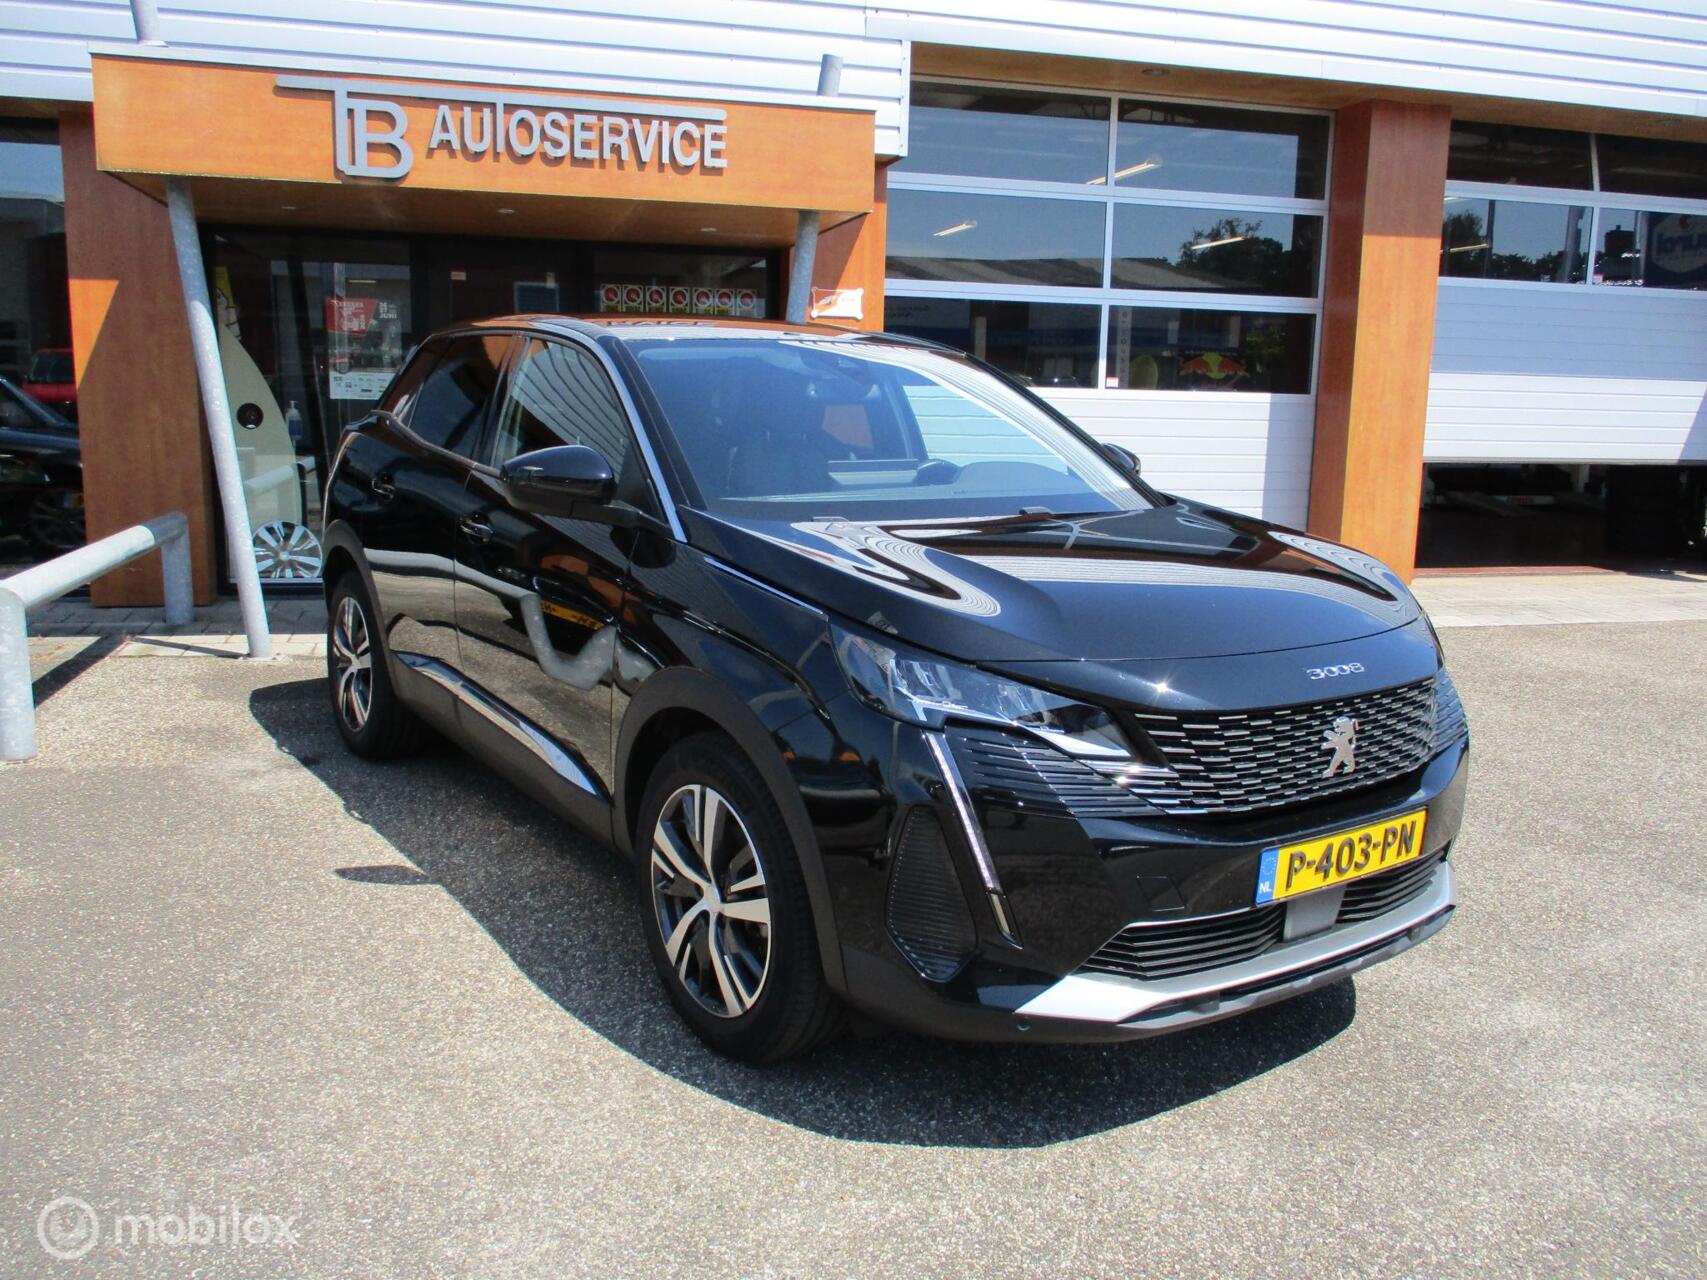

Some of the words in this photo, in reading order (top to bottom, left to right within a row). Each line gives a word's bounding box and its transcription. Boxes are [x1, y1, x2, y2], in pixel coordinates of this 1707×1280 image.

[428, 99, 728, 169] AUTOSERVICE
[1306, 662, 1365, 681] 3008
[1258, 882, 1273, 894] NL
[1285, 820, 1417, 892] P-403-PN
